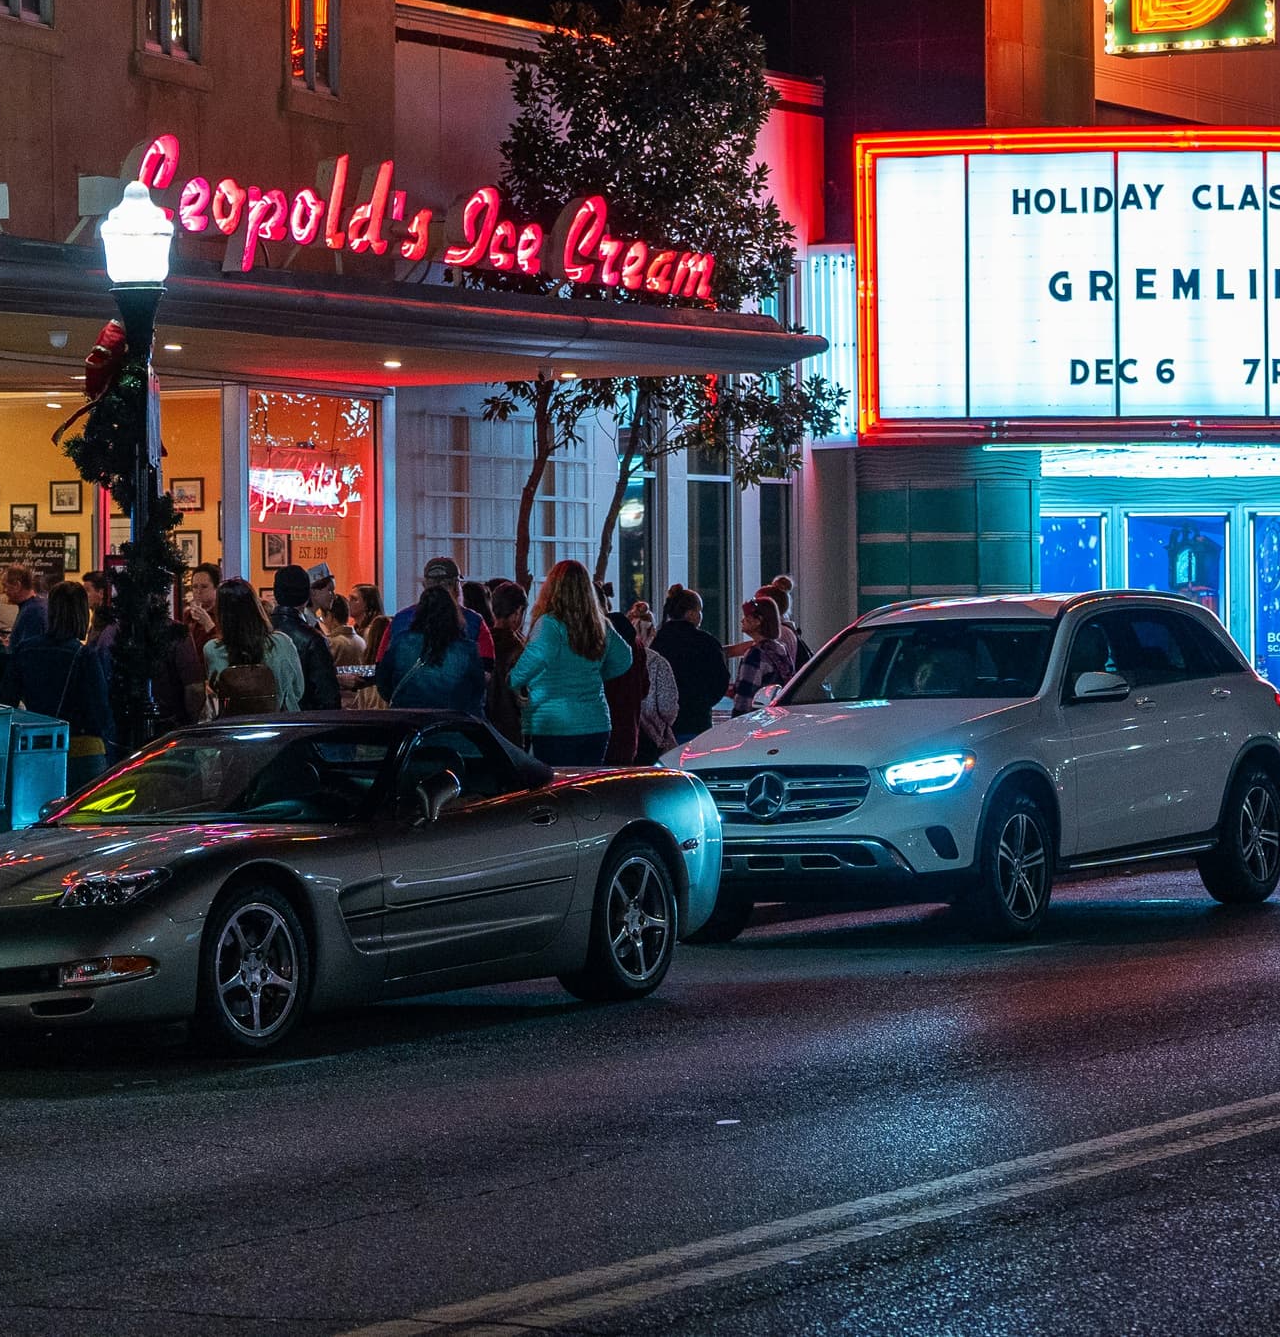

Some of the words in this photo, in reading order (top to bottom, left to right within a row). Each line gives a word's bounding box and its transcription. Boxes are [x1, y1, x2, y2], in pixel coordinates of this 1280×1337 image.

[1012, 184, 1163, 215] HOLIDAY
[138, 134, 431, 271] Leopold's
[446, 187, 543, 275] Ice
[563, 195, 715, 299] Cream
[1070, 359, 1137, 385] DEC
[1155, 358, 1176, 384] 6
[16, 538, 31, 548] UP
[33, 538, 64, 548] WITH
[290, 525, 305, 542] ICE
[306, 526, 336, 542] CREAM
[313, 546, 328, 560] 1919
